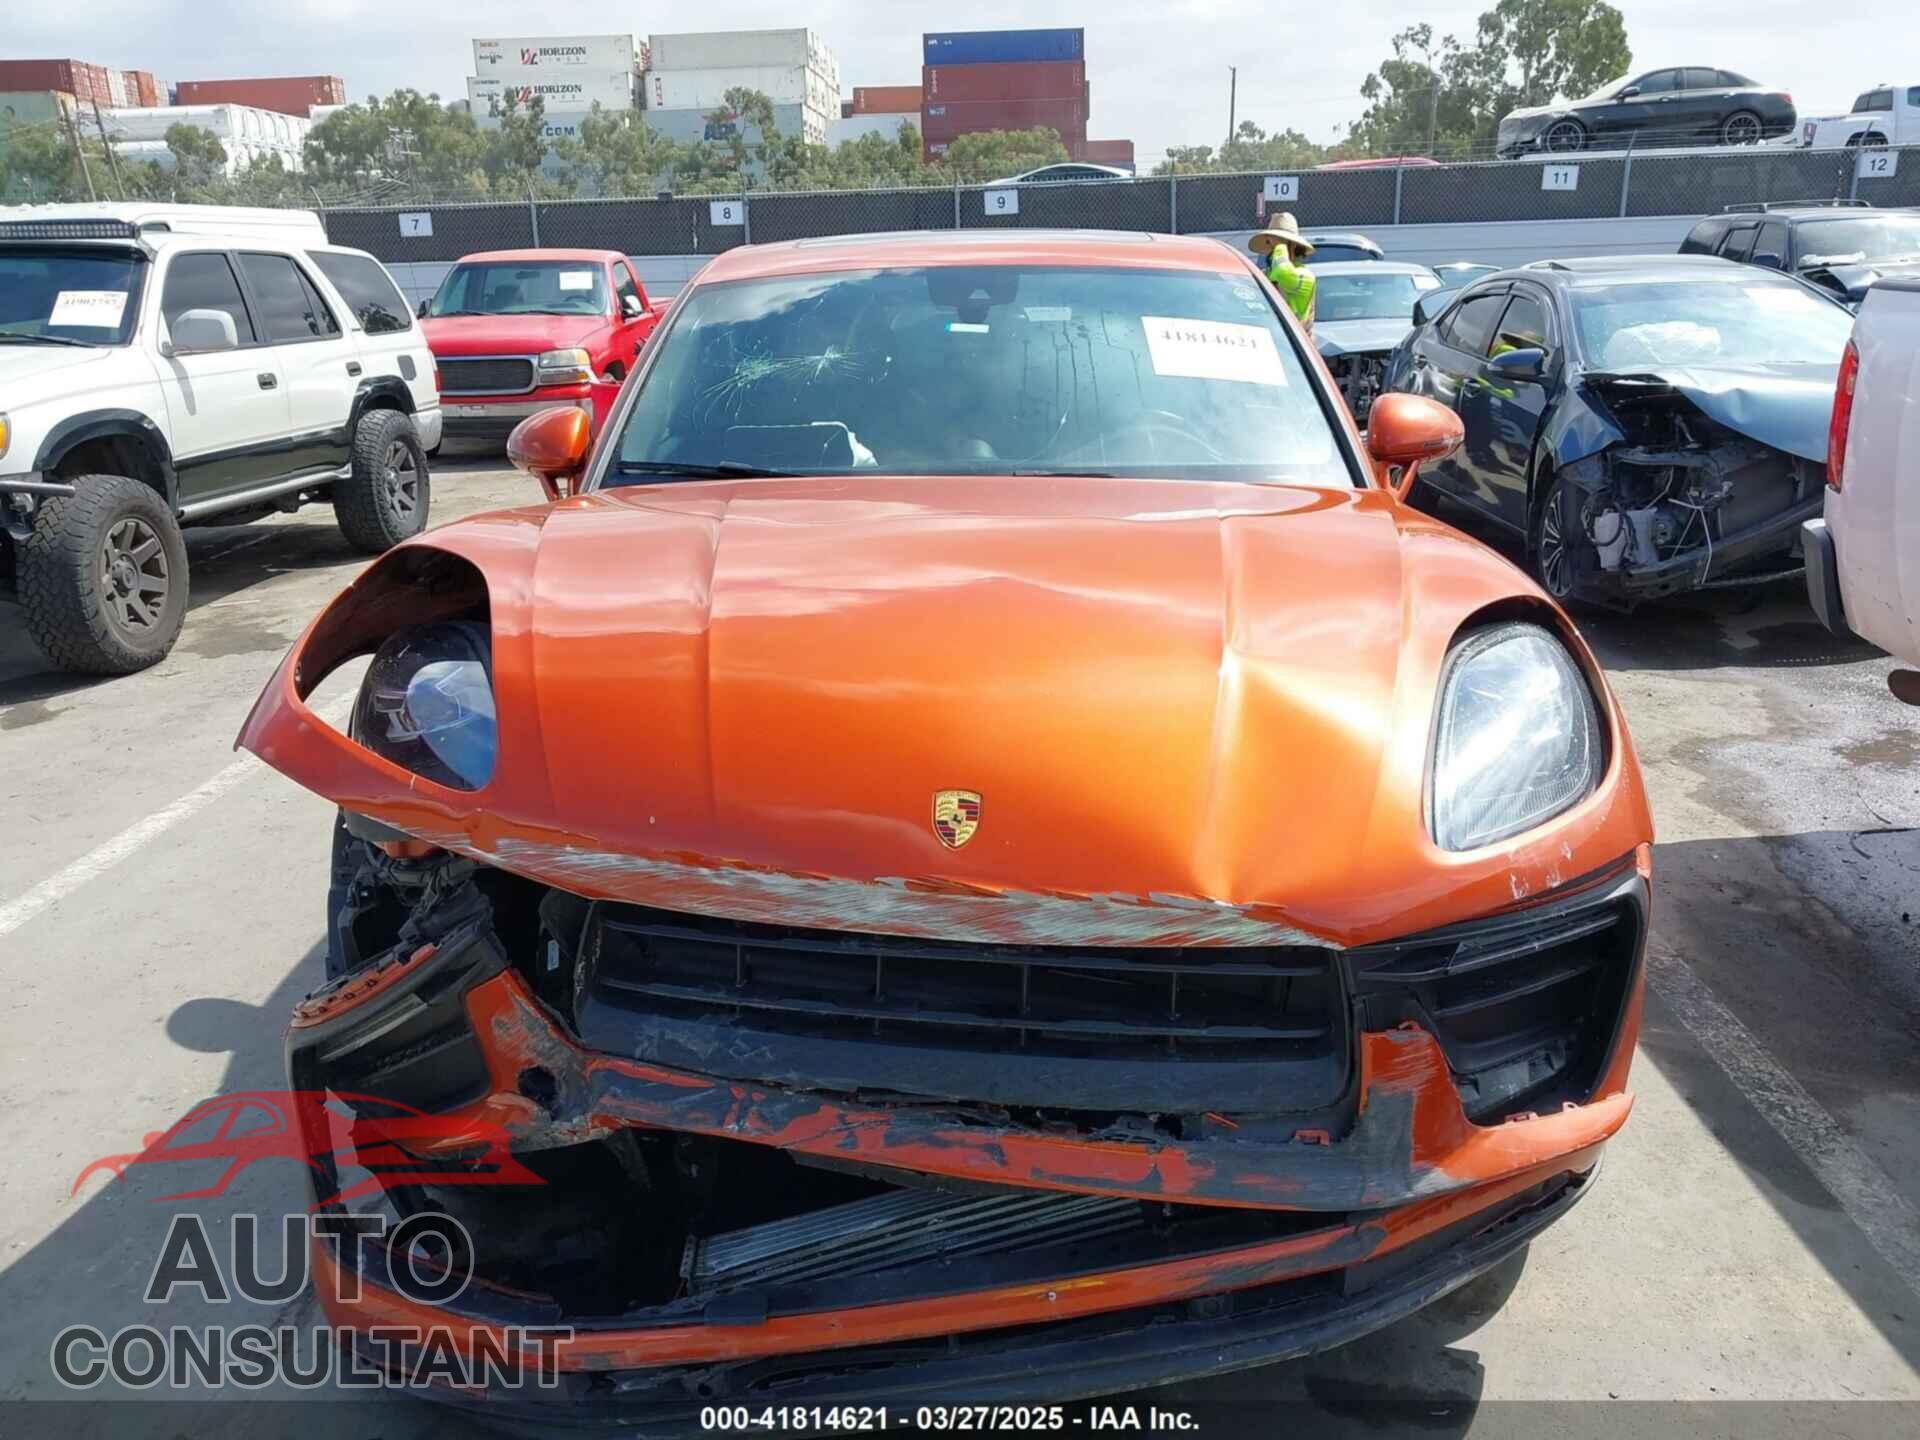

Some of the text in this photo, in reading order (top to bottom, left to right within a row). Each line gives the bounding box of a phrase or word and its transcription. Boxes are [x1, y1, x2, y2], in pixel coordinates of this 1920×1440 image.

[539, 47, 587, 57] HORIZON
[534, 84, 583, 94] HORIZON
[1869, 158, 1888, 171] 12
[1552, 171, 1569, 185] 11
[1272, 182, 1290, 196] 10
[997, 196, 1006, 209] 9
[723, 206, 732, 220] 8
[410, 218, 420, 231] 7
